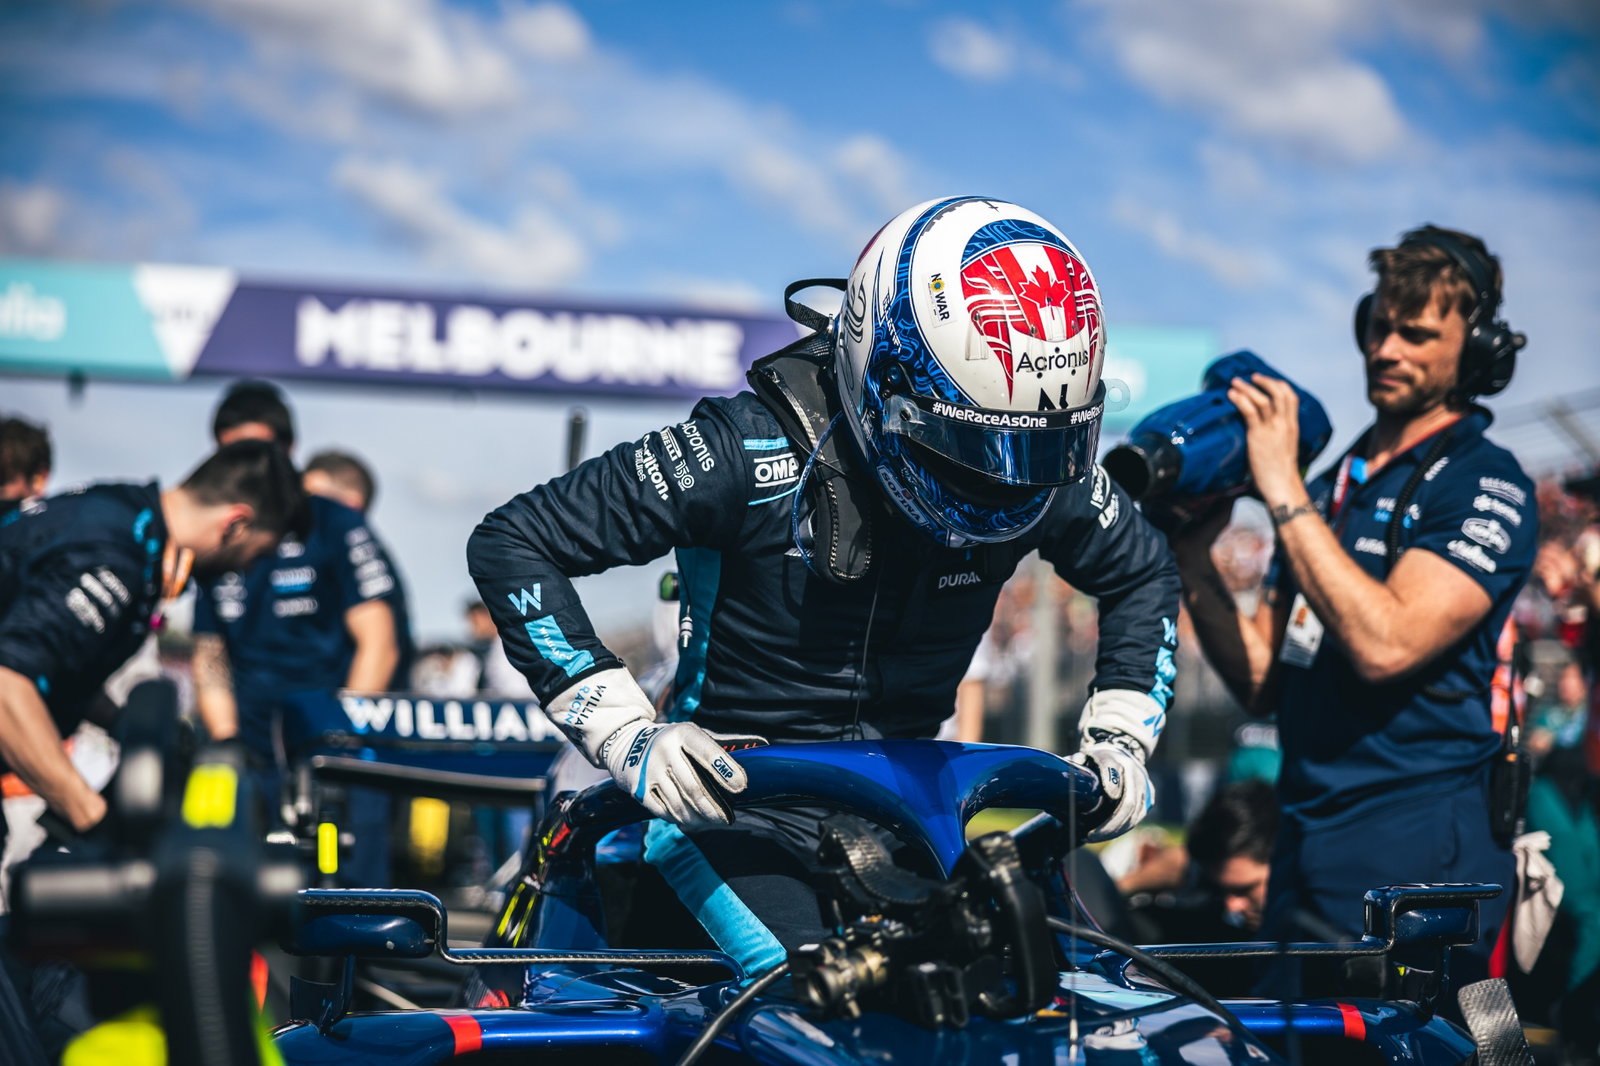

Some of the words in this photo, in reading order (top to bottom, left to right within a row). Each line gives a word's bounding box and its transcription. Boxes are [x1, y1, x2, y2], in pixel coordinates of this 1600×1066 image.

[935, 291, 950, 321] WAR
[295, 296, 744, 389] MELBOURNE
[1016, 350, 1089, 374] Acronis
[932, 401, 1048, 428] #WeRaceAsOne
[681, 420, 715, 472] Acronis
[754, 457, 799, 483] OMP
[881, 471, 921, 521] SOFINA
[712, 757, 735, 780] OMP
